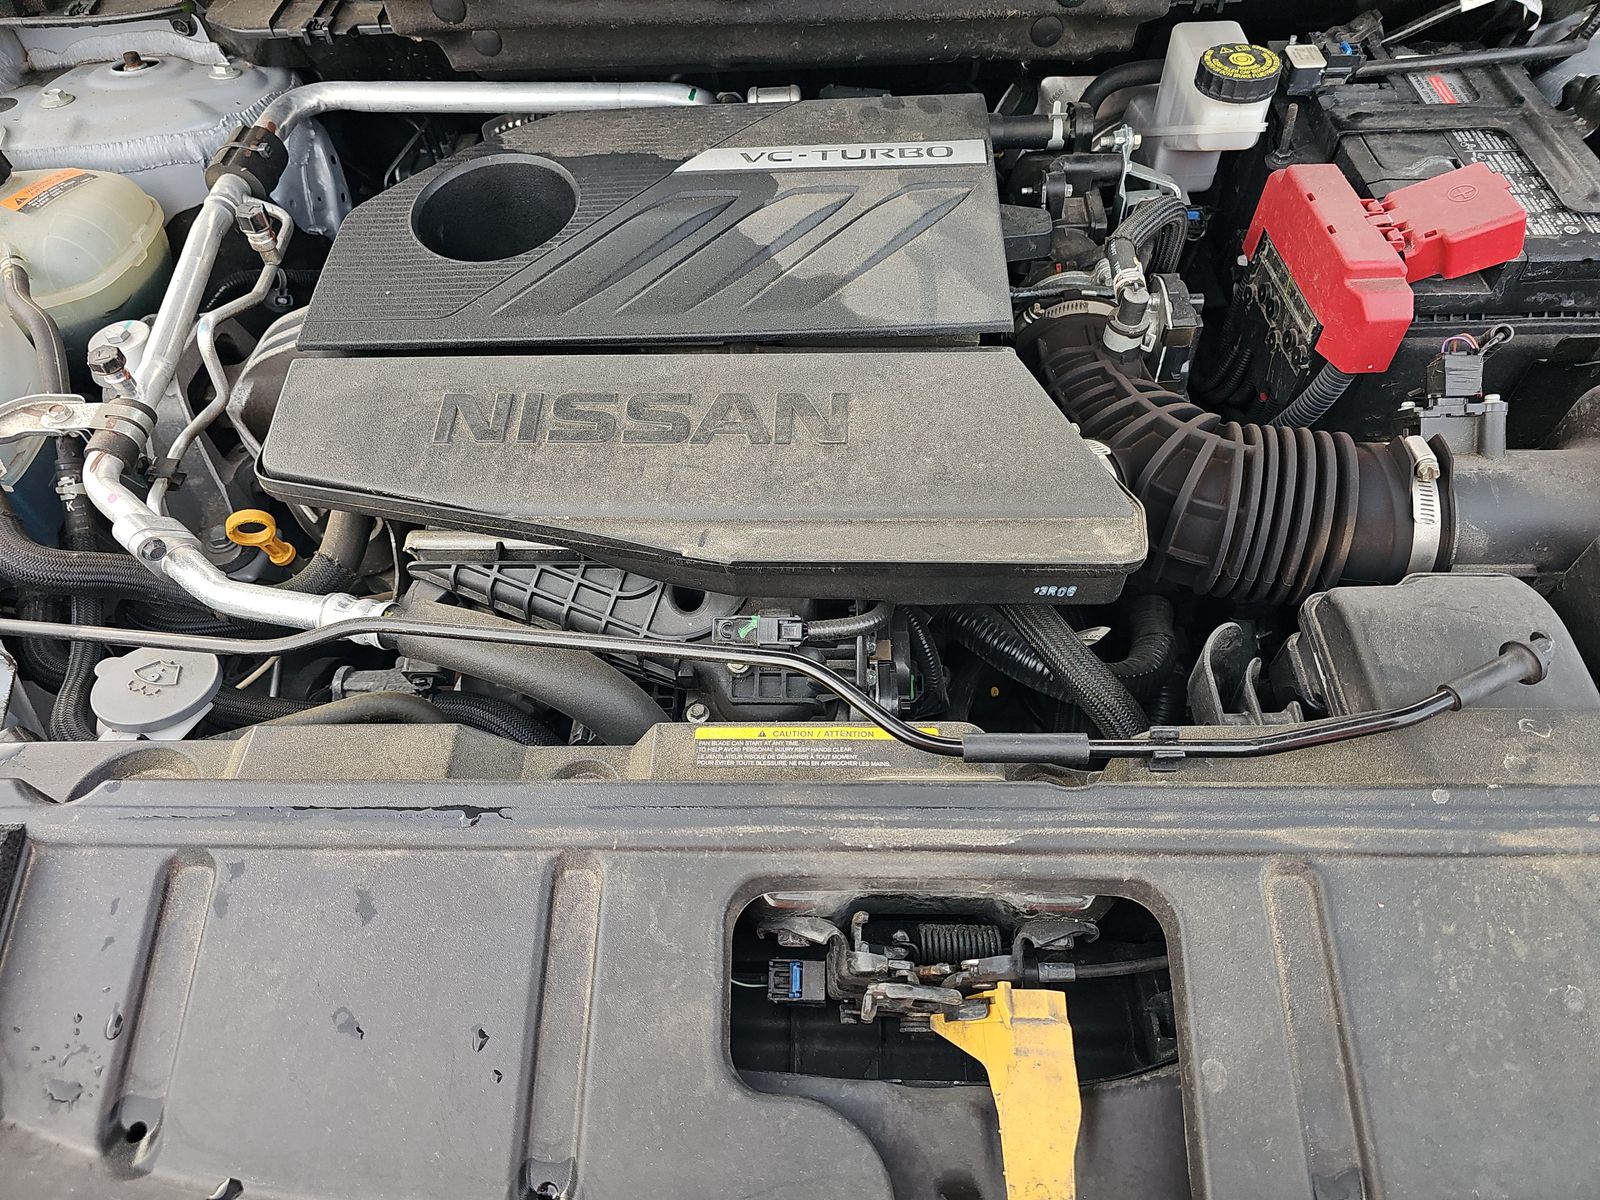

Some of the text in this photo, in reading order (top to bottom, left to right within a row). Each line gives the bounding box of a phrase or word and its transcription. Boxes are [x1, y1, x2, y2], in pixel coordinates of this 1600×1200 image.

[740, 145, 954, 164] VC-TURBO
[432, 392, 850, 445] NISSAN
[66, 501, 75, 512] K
[772, 730, 814, 738] CAUTION
[823, 730, 875, 738] ATTENTION
